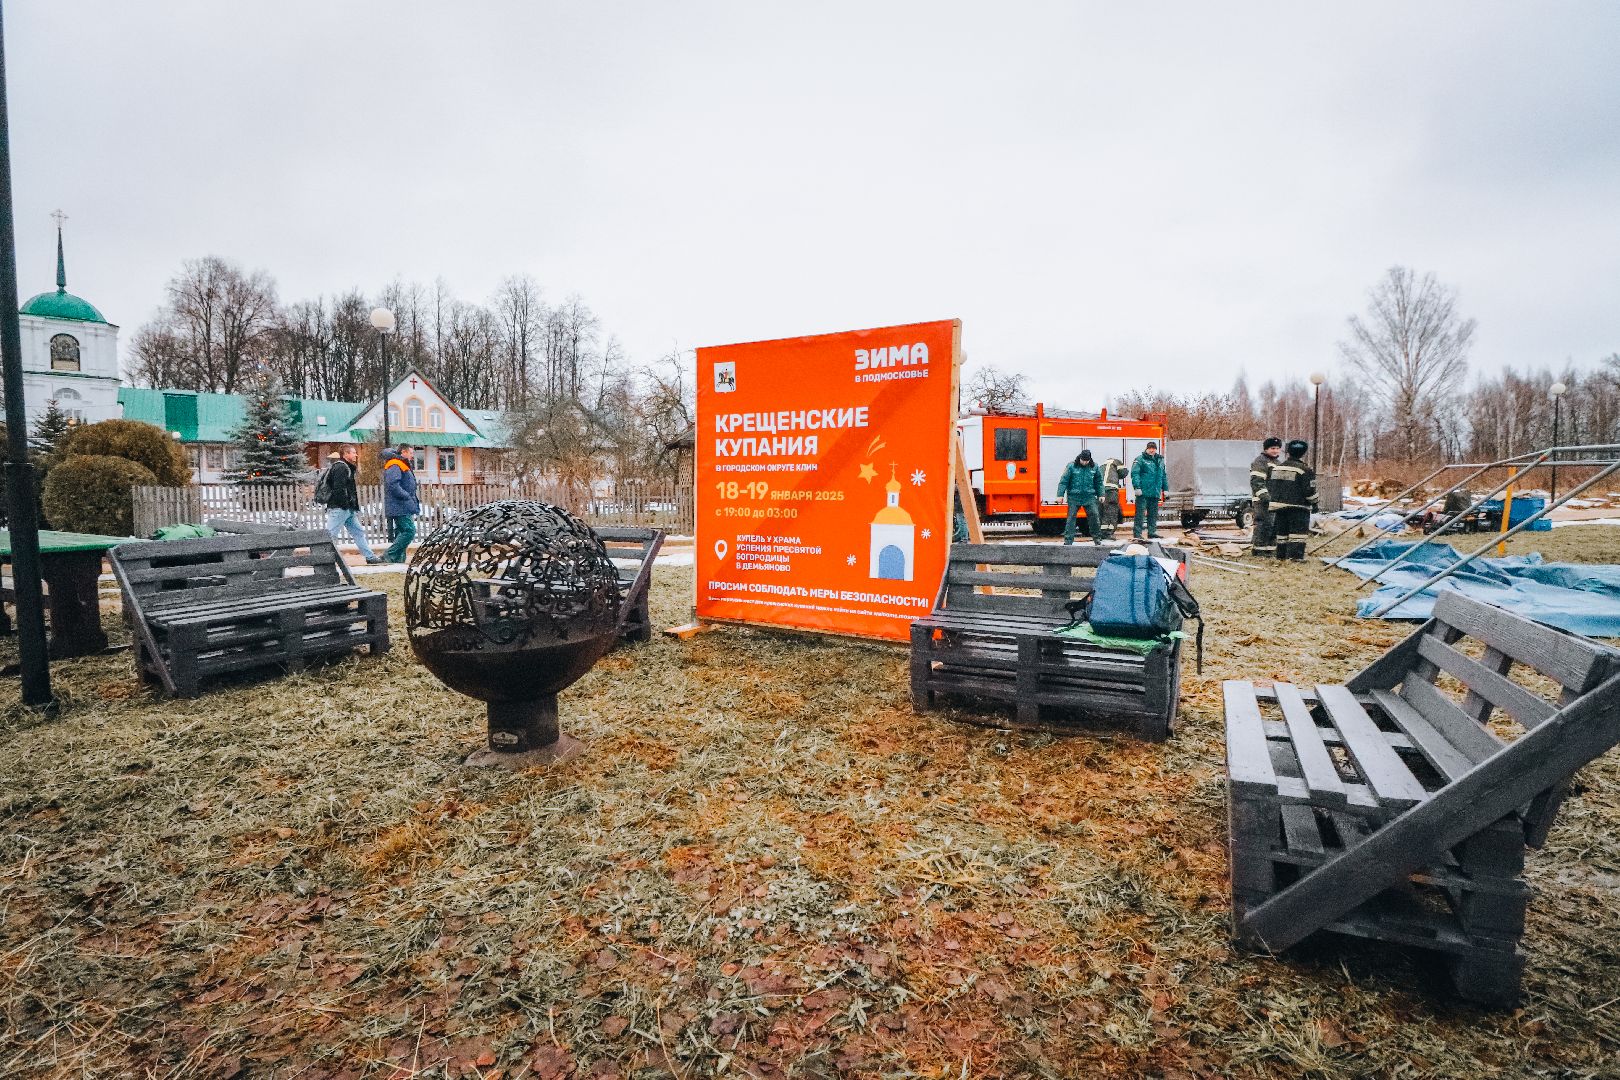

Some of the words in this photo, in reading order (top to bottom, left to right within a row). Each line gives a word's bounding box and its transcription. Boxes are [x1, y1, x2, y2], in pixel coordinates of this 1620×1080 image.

[855, 342, 929, 371] ЗИМА
[862, 369, 929, 383] ПОДМОСКОВЬЕ
[715, 406, 869, 435] КРЕЩЕНСКИЕ
[715, 435, 818, 457] КУПАНИЯ
[722, 464, 766, 473] ГОРОДСКОМ
[767, 463, 795, 472] ОКРУГЕ
[796, 463, 818, 472] КЛИН
[715, 481, 769, 500] 18-19
[770, 490, 813, 501] ЯНВАРЯ
[815, 490, 845, 501] 2025
[724, 507, 751, 517] 19:00
[752, 509, 765, 519] до
[767, 507, 798, 519] 03:00
[736, 534, 765, 543] КУПЕЛЬ
[767, 535, 772, 543] У
[773, 536, 801, 545] ХРАМА
[736, 544, 772, 553] УСПЕНИЯ
[773, 545, 822, 555] ПРЕСВЯТОЙ
[736, 553, 790, 563] БОГОРОДИЦЫ
[742, 562, 791, 572] ДЕМЬЯНОВО
[708, 581, 748, 592] ПРОСИМ
[748, 583, 809, 597] СОБЛЮДАТЬ
[809, 587, 839, 600] МЕРЫ
[840, 590, 929, 609] БЕЗОПАСНОСТИ!
